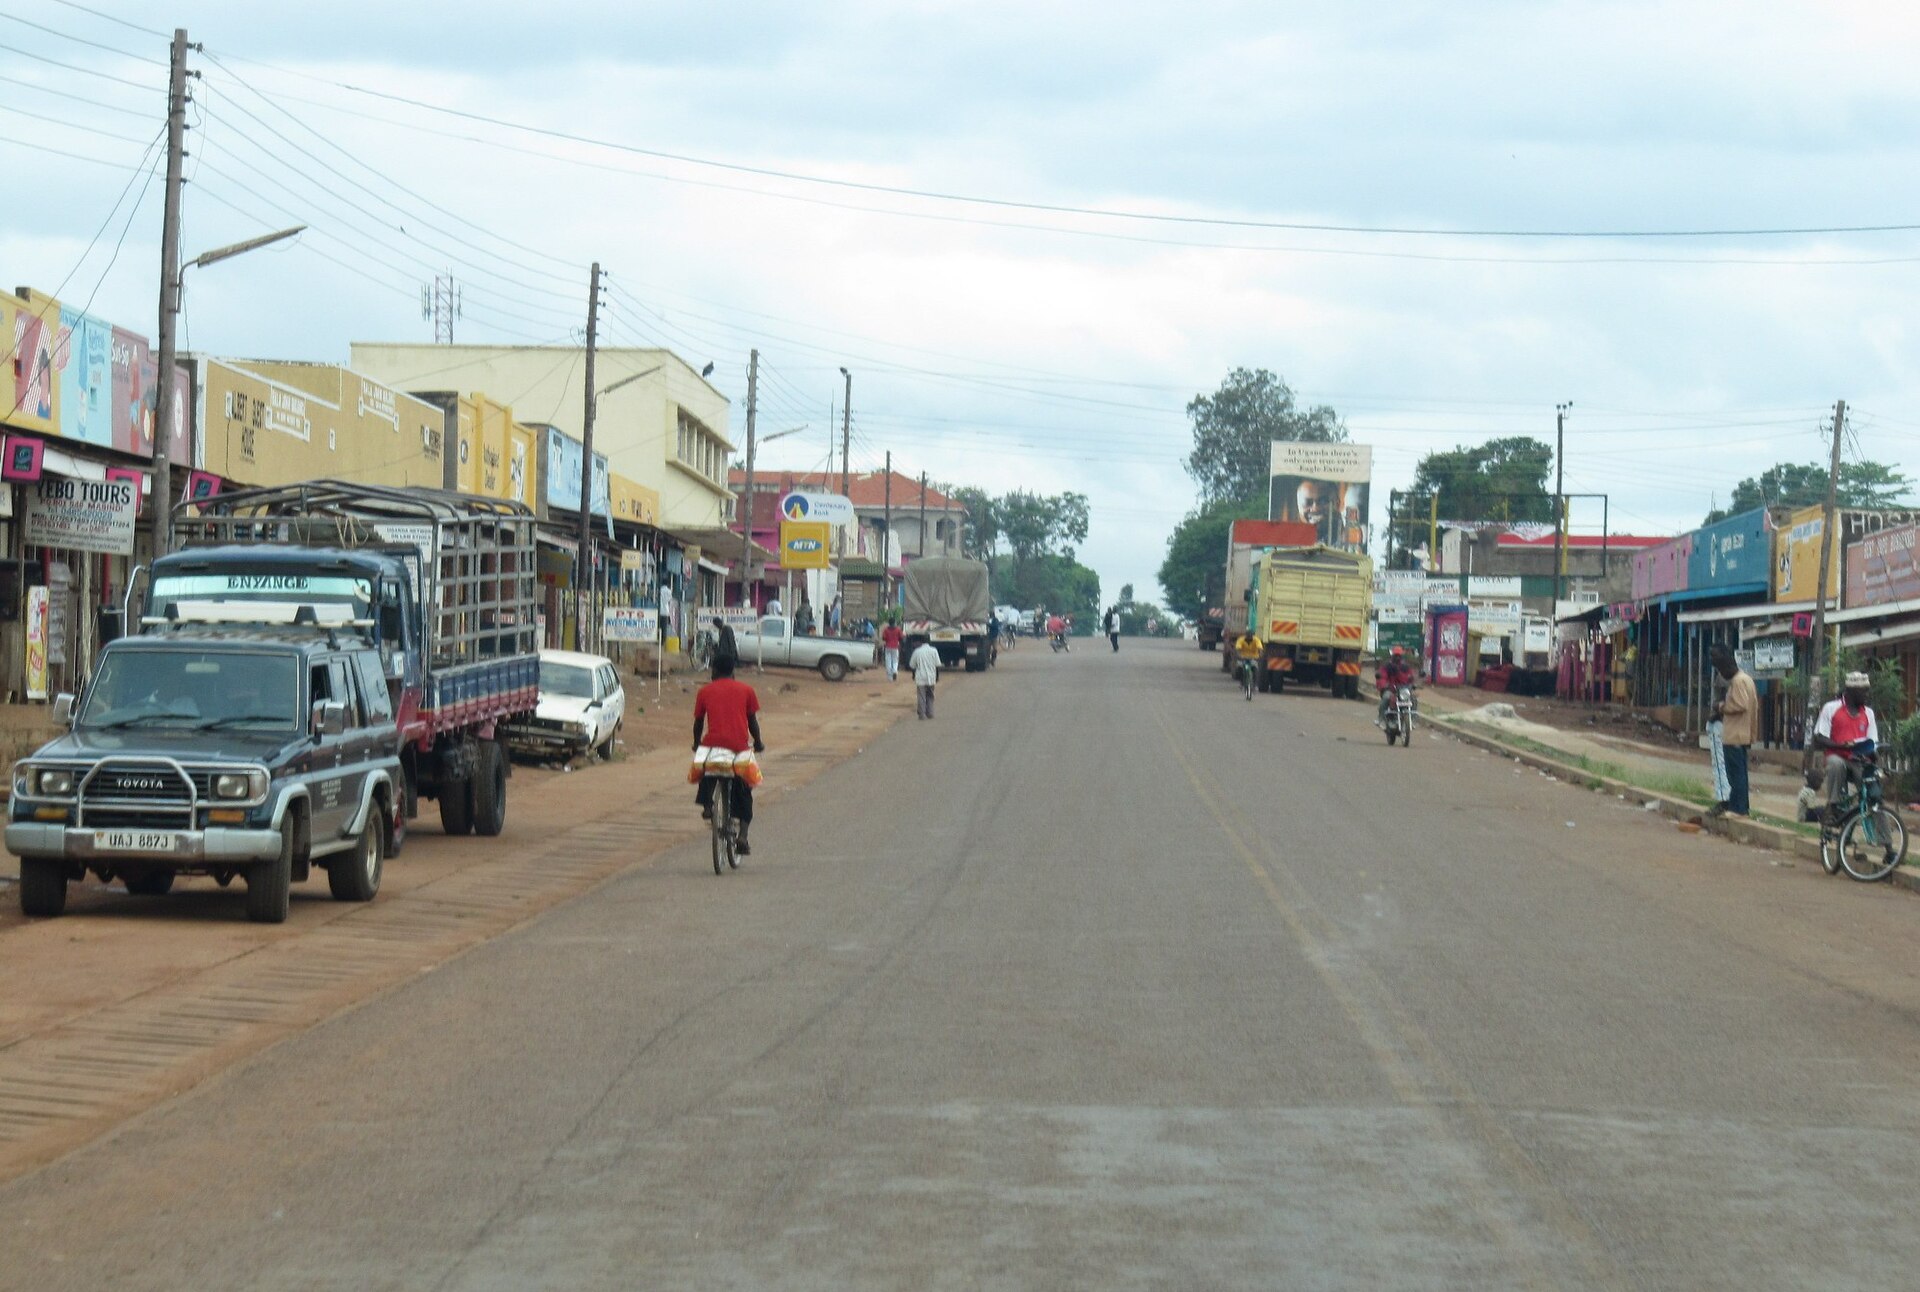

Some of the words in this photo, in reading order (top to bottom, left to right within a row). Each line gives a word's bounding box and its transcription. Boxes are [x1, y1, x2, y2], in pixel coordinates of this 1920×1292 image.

[1299, 448, 1328, 457] Uganda
[37, 479, 75, 500] YEBO
[81, 481, 130, 505] TOURS
[814, 502, 846, 510] Centenary
[793, 540, 816, 550] MTN
[117, 779, 164, 789] TOYOTA
[109, 832, 133, 848] UAJ
